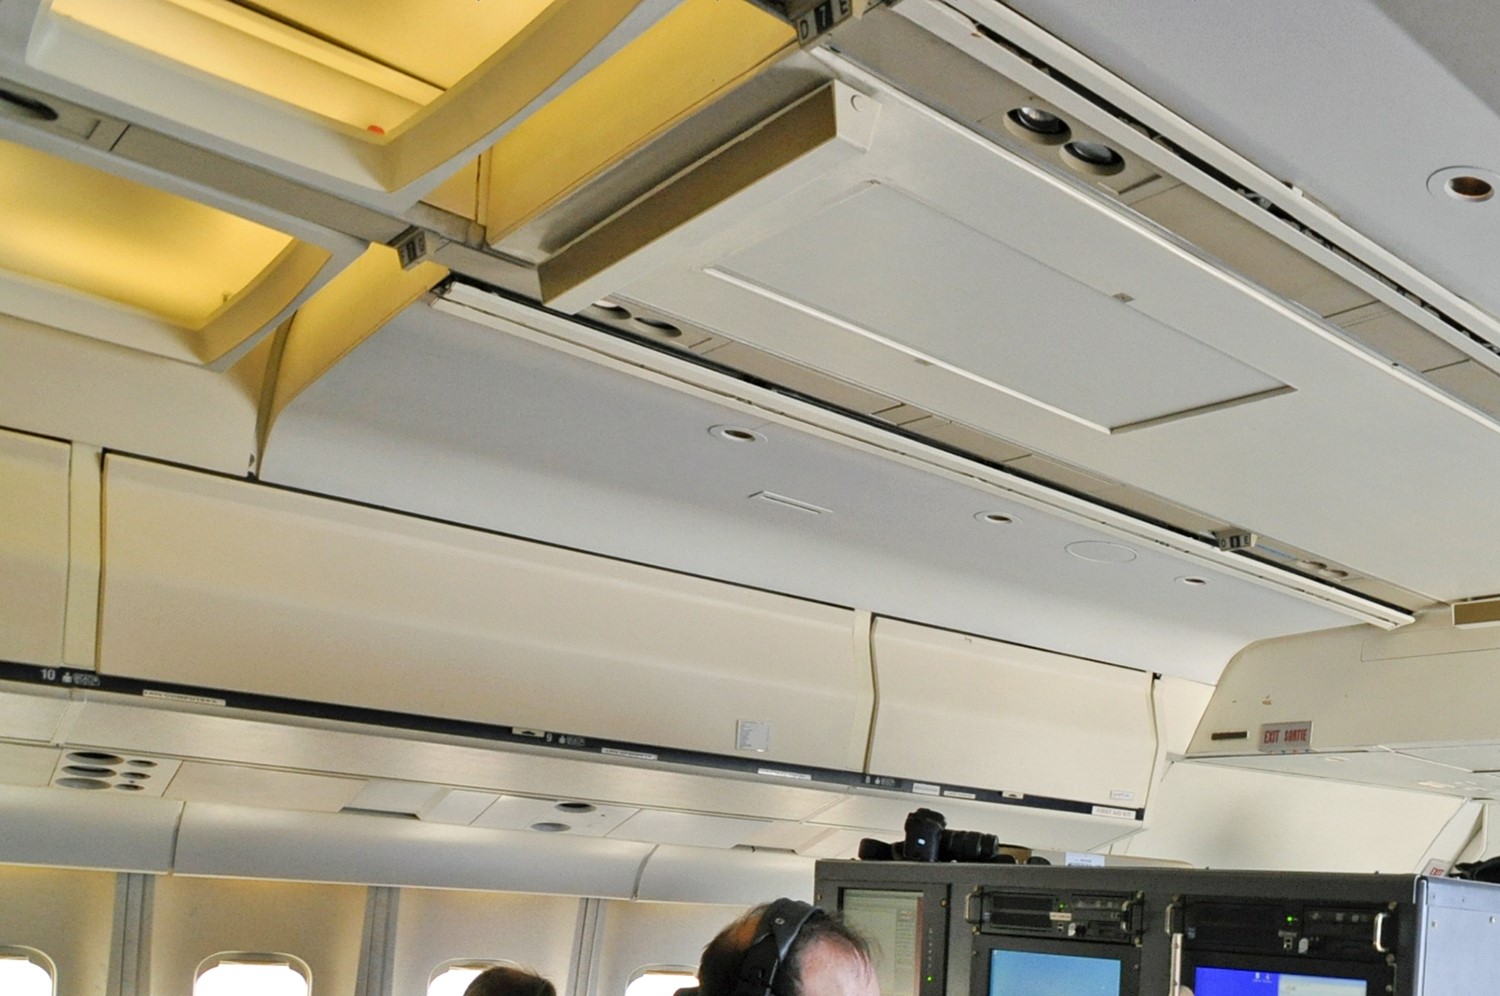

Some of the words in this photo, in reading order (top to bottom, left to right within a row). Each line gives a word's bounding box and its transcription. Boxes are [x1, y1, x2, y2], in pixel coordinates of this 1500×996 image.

[41, 668, 56, 681] 10
[546, 733, 553, 743] 9
[1264, 730, 1280, 744] EXIT
[1284, 729, 1308, 742] SORTIE
